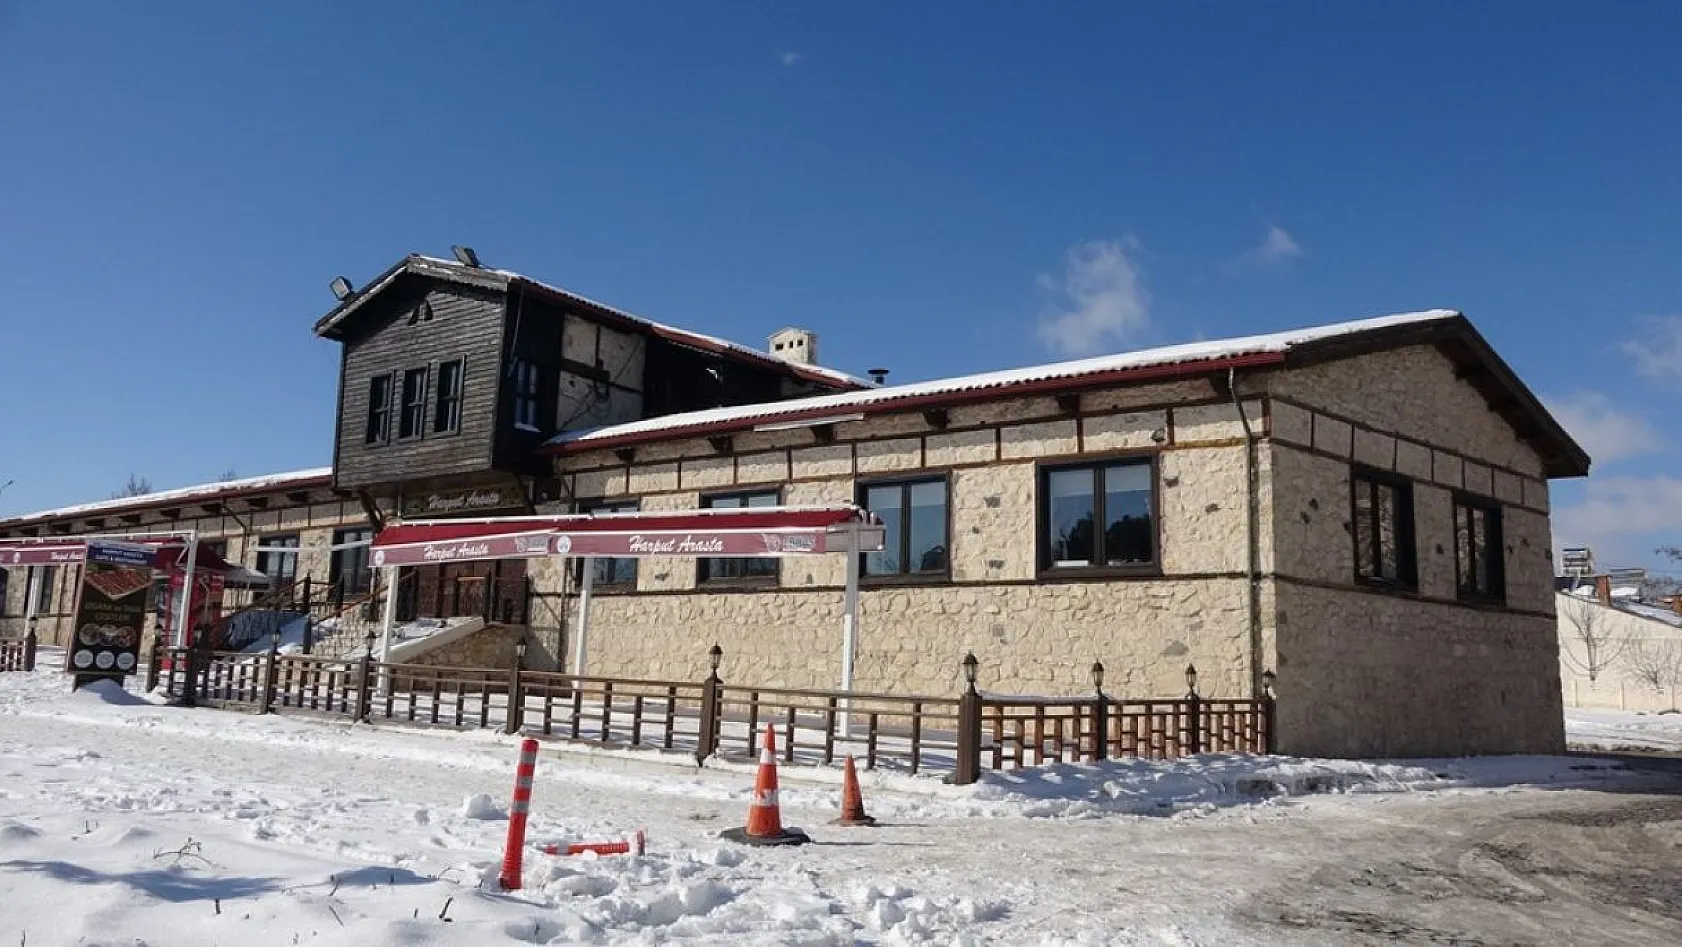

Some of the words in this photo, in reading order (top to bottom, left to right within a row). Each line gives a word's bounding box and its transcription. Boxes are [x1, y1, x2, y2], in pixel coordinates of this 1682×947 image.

[423, 544, 457, 562] Harput
[457, 542, 489, 557] Arasta
[629, 535, 676, 556] Harput
[677, 534, 723, 553] Arasta
